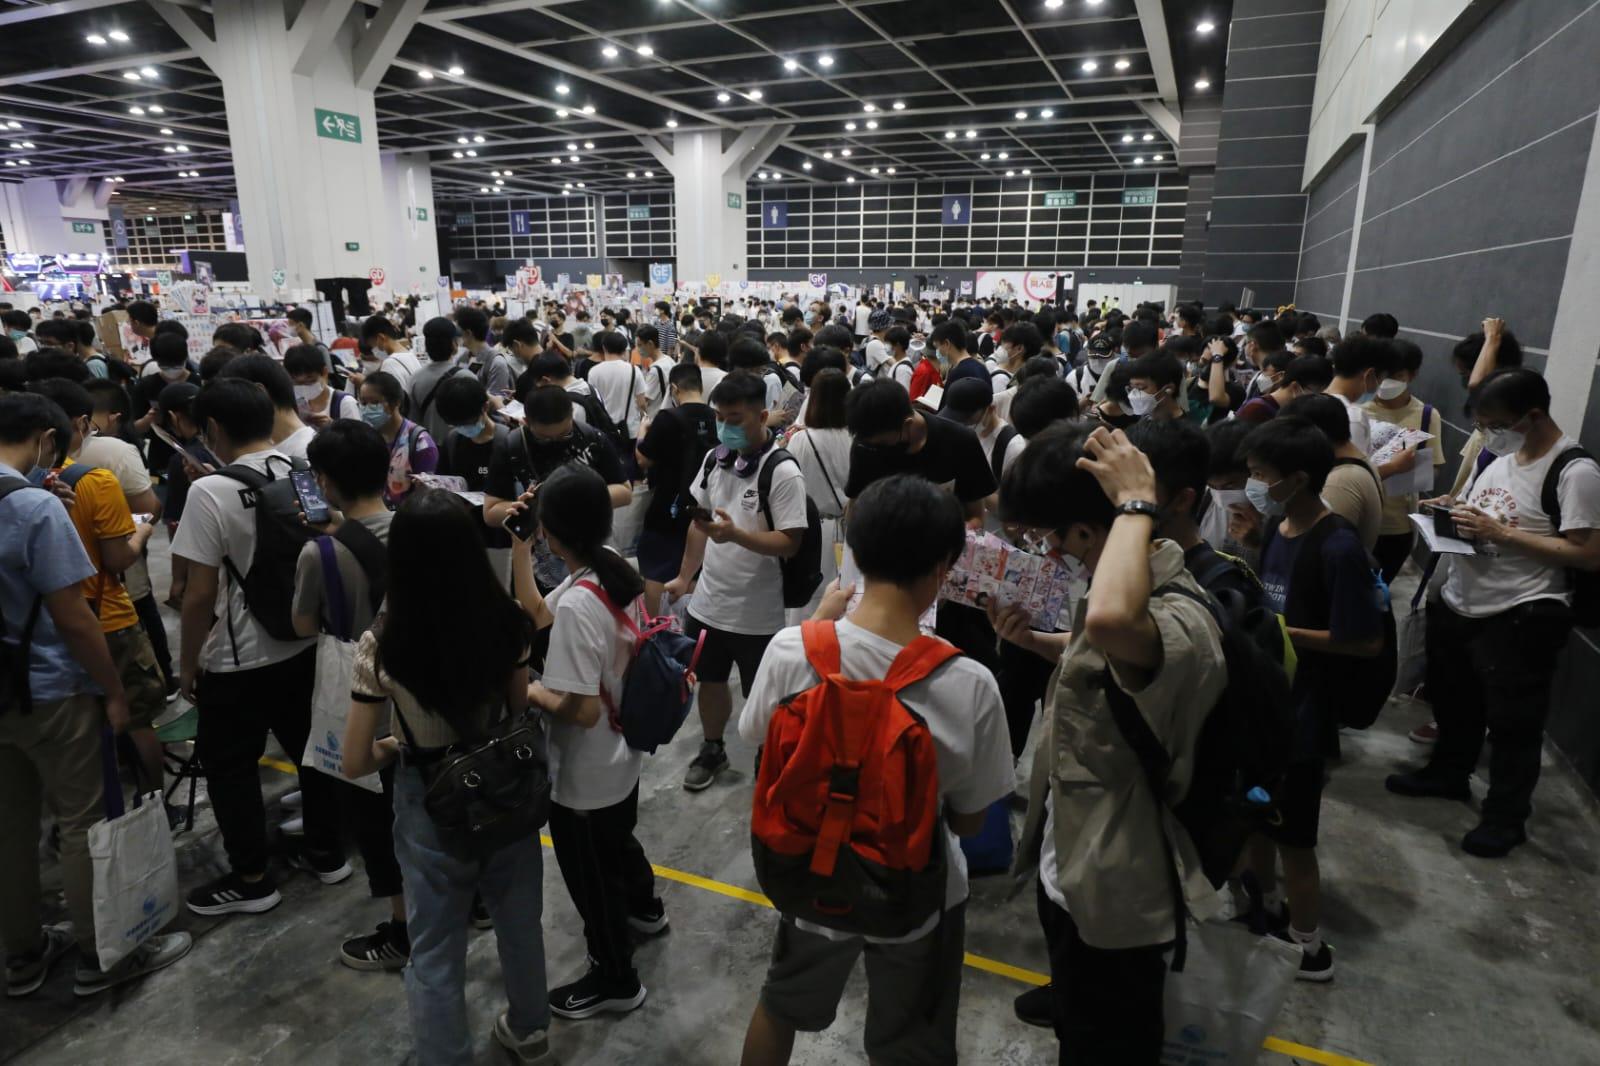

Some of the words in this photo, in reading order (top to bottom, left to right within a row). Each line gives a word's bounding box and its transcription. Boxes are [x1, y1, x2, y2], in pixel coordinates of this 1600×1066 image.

[370, 267, 383, 279] GD
[653, 265, 669, 277] GE
[811, 273, 824, 284] GK
